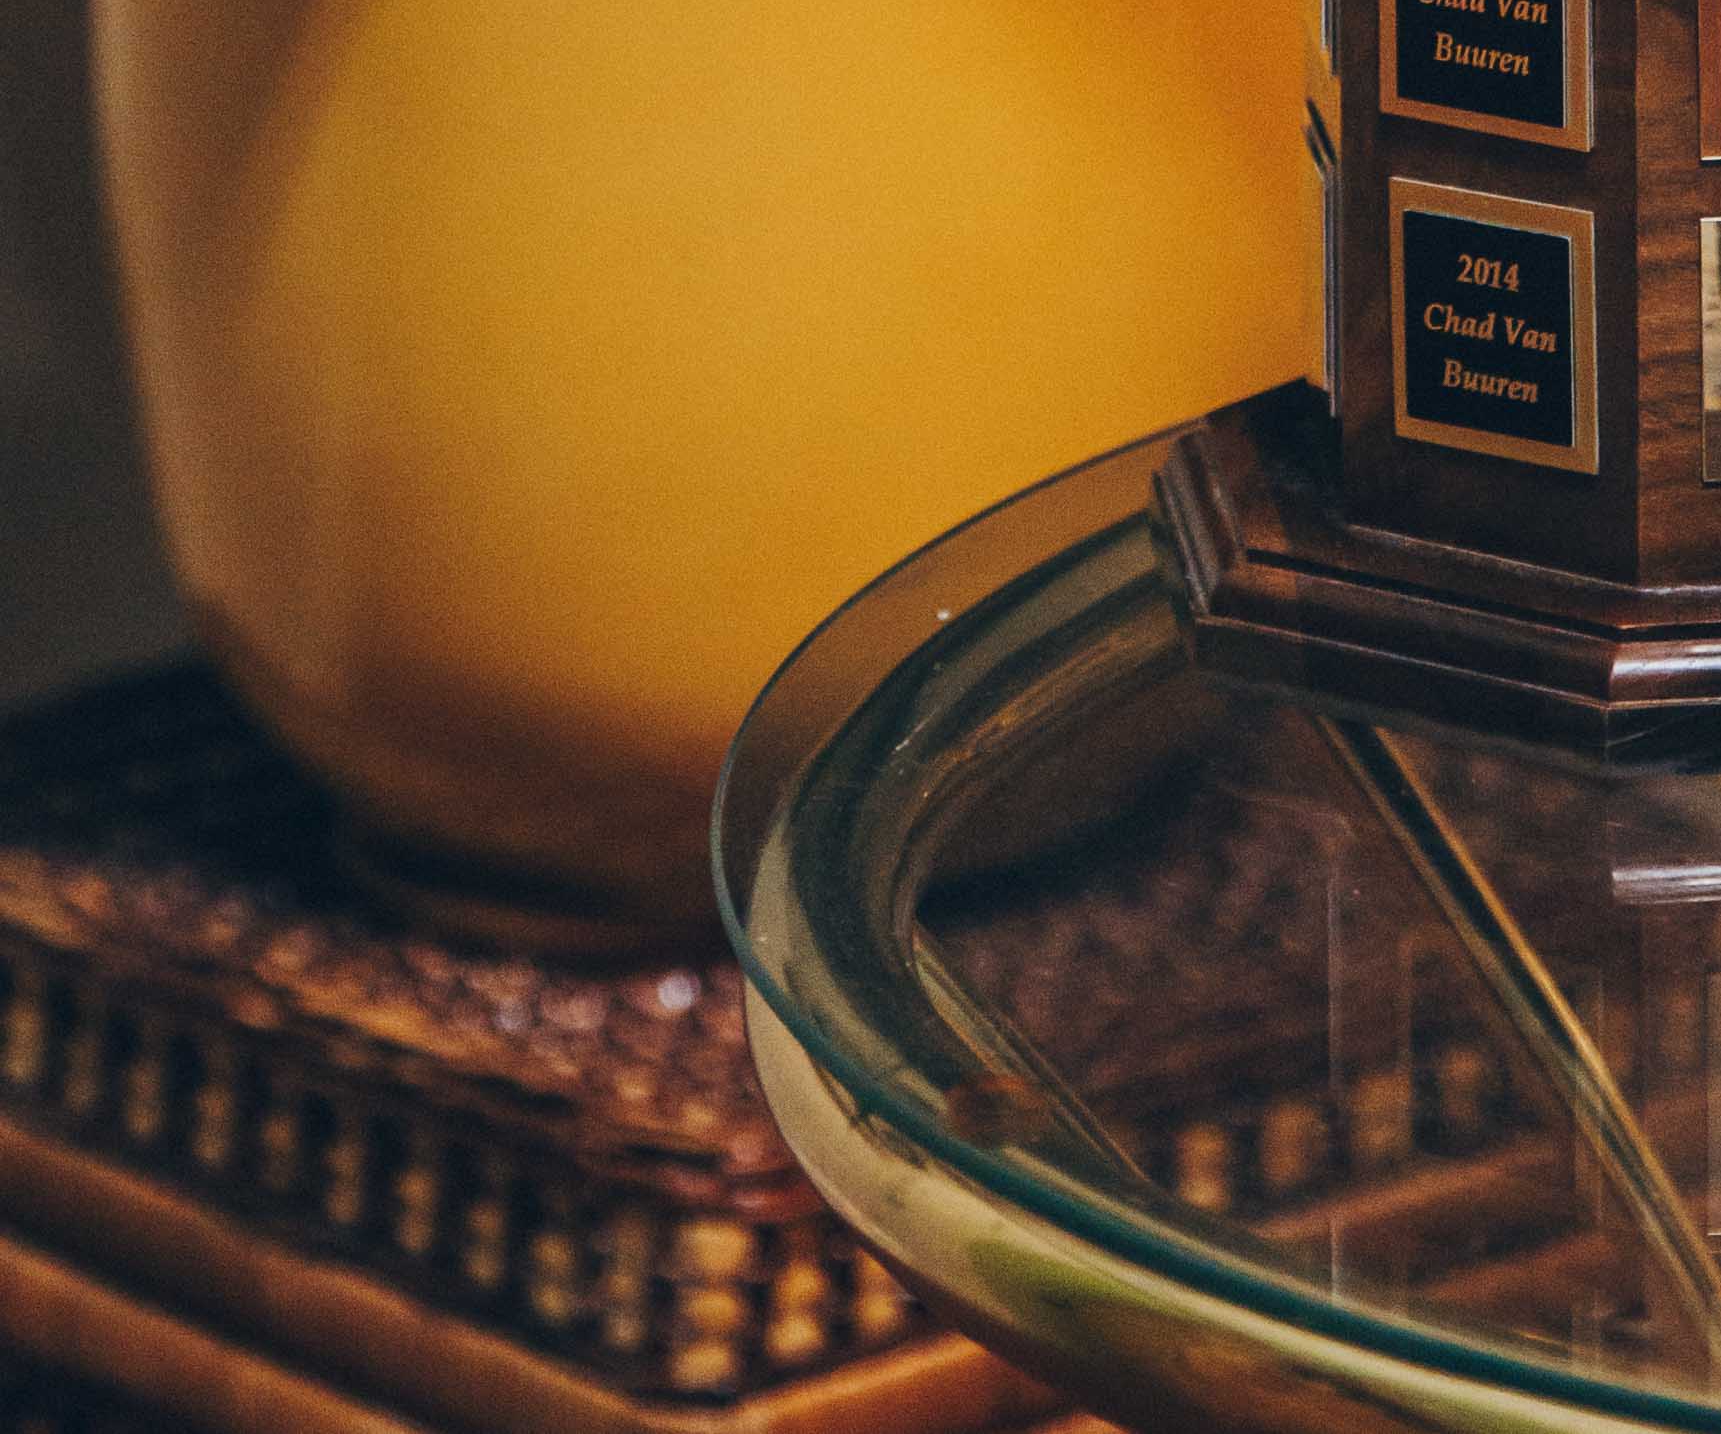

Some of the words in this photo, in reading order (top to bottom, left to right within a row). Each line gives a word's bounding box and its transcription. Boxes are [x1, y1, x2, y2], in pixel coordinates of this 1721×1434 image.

[1433, 31, 1531, 77] Buuren
[1456, 253, 1520, 293] 2014
[1423, 302, 1497, 341] Chad
[1503, 315, 1558, 354] Van
[1442, 357, 1539, 404] Buuren
